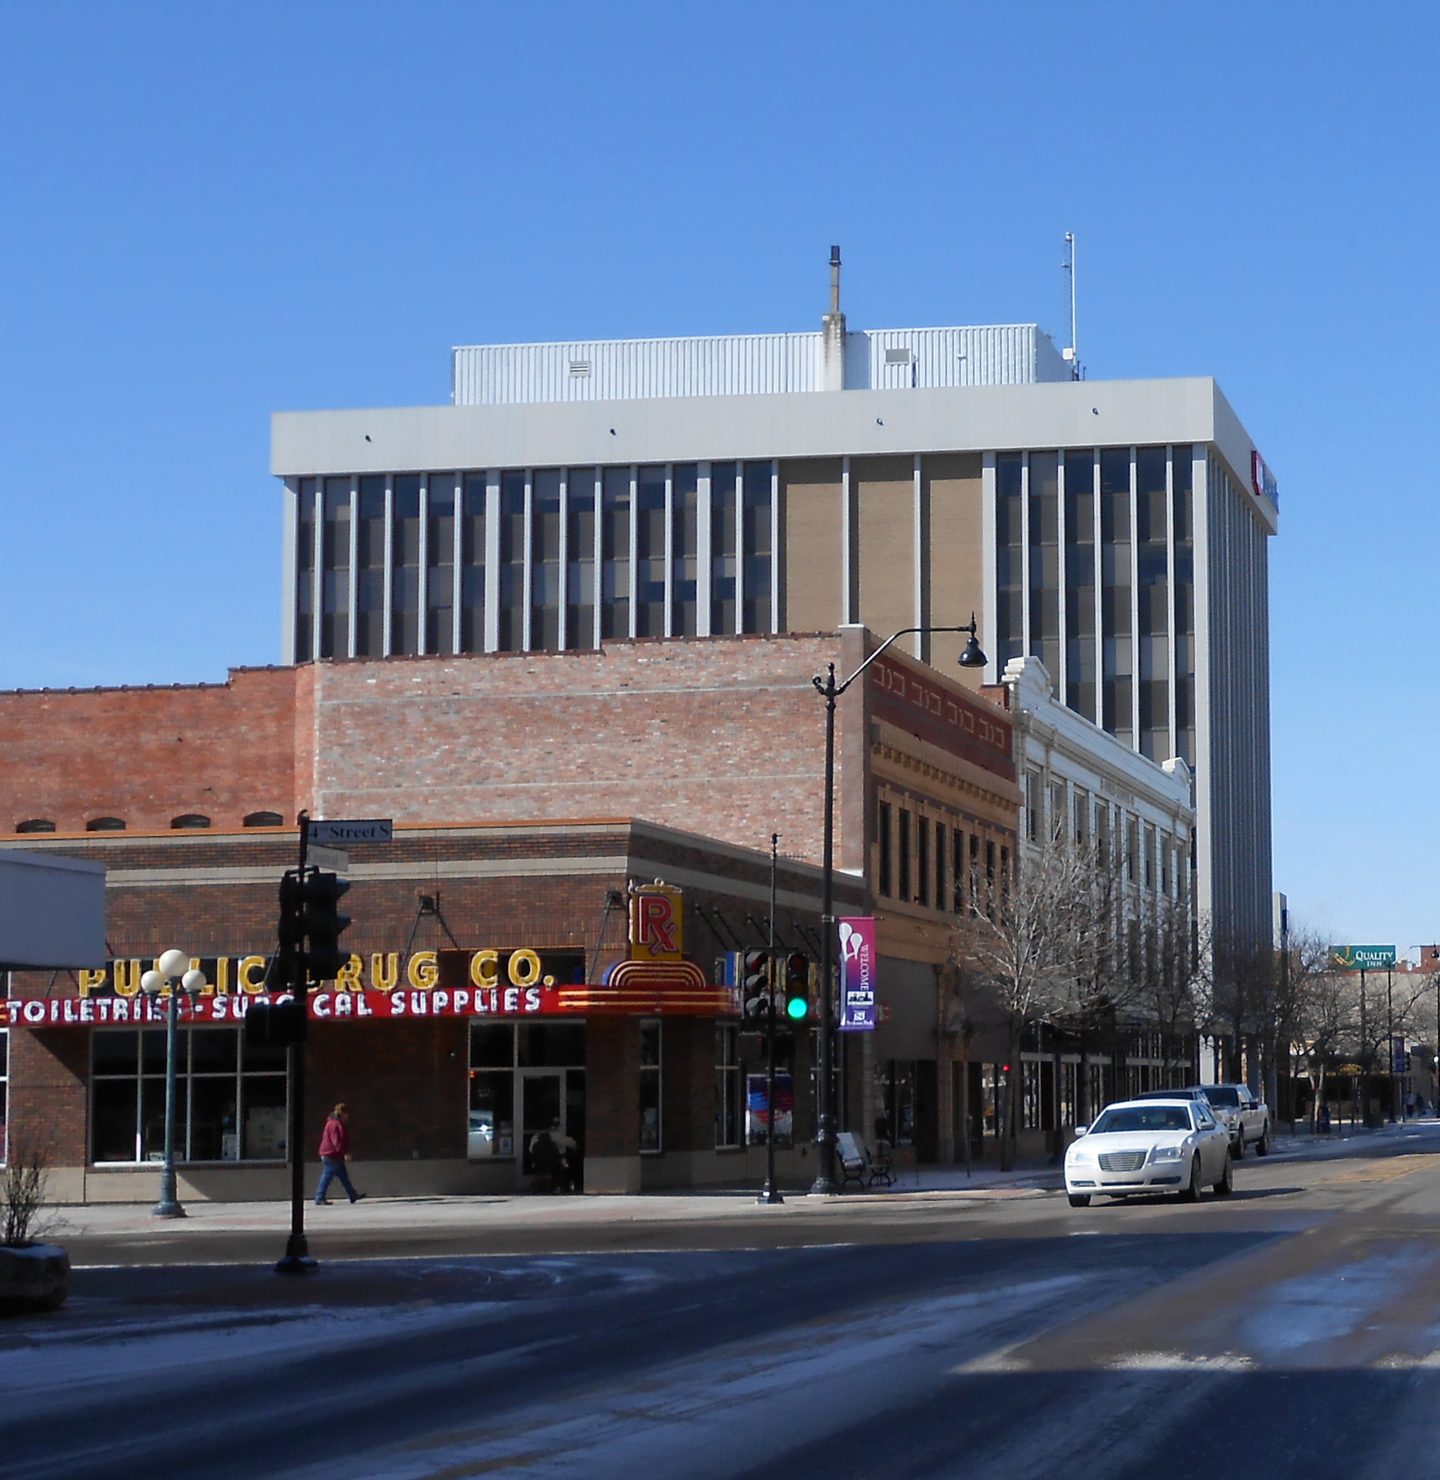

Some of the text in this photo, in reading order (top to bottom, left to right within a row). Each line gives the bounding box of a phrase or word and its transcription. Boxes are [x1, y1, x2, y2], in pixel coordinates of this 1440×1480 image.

[329, 825, 375, 839] Street
[379, 824, 390, 838] S
[860, 944, 870, 992] WELCOME
[1355, 950, 1393, 961] QUALITY
[78, 948, 556, 998] PULIC RUG CO.
[211, 992, 373, 1020] SUCAL
[391, 987, 541, 1014] SUPPLIES
